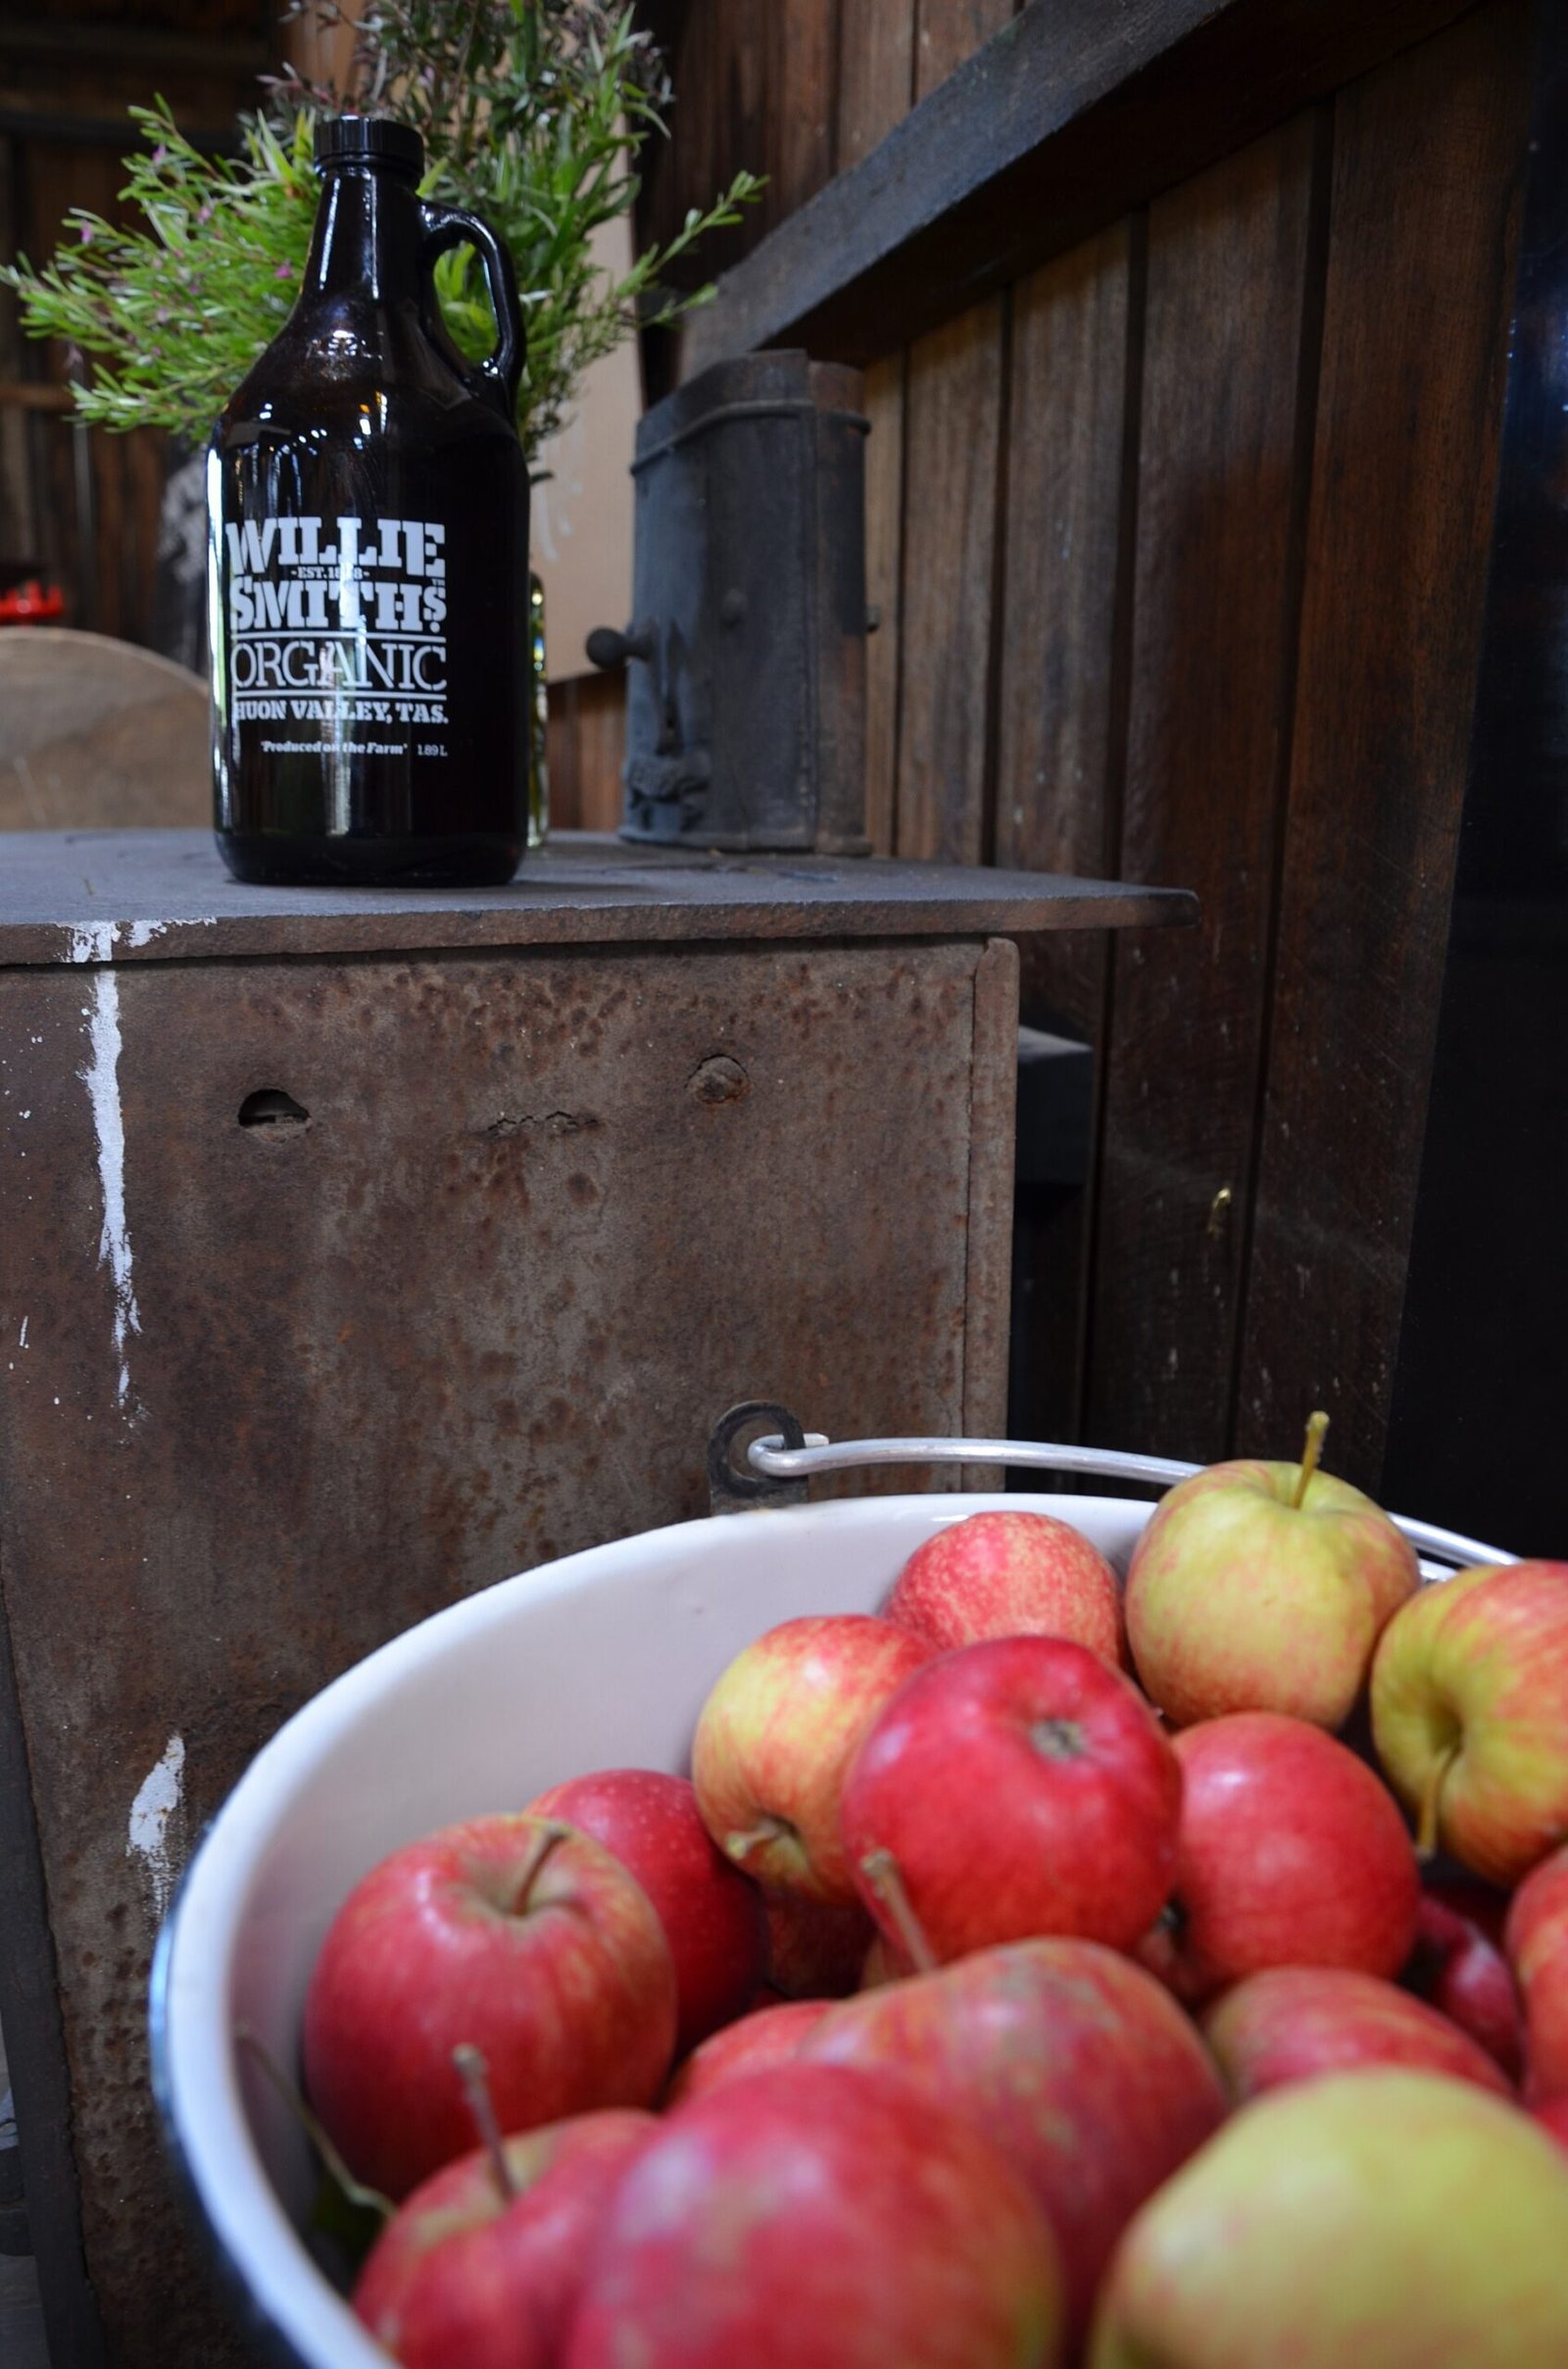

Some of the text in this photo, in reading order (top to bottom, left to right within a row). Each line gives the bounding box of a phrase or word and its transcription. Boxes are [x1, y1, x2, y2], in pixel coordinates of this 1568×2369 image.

[225, 517, 446, 578] WILLIE
[230, 640, 447, 691] ORGANIC
[234, 700, 449, 724] HUON VALLEY, TAS.
[342, 741, 367, 755] the
